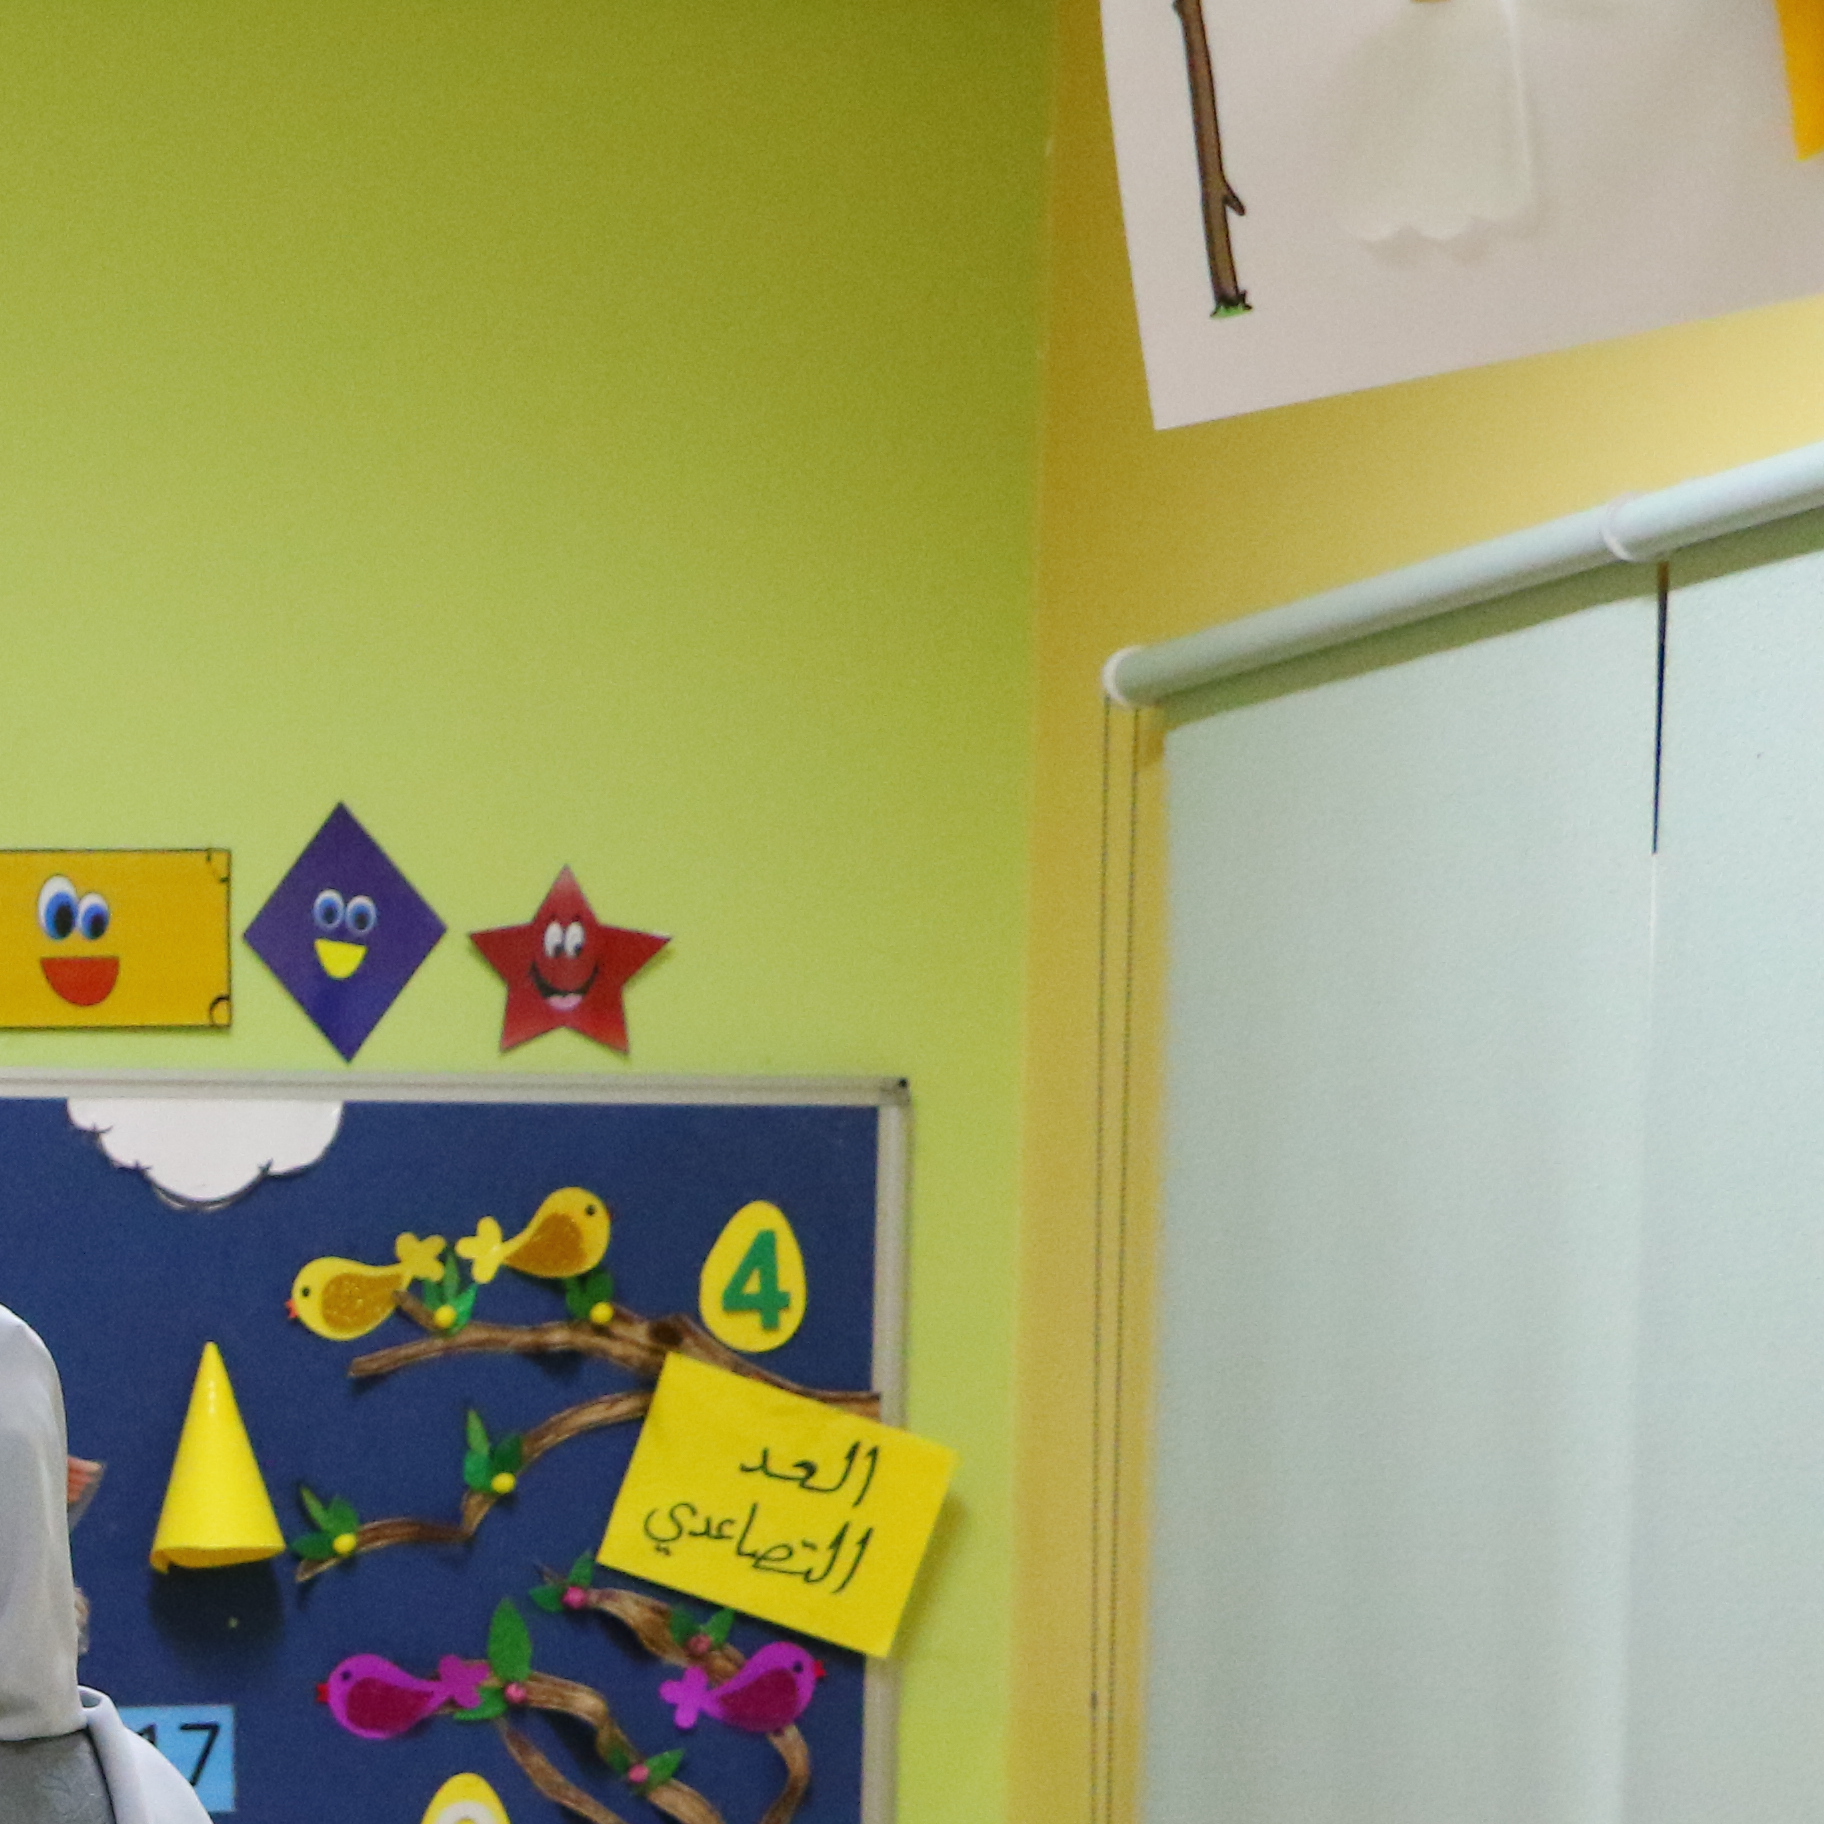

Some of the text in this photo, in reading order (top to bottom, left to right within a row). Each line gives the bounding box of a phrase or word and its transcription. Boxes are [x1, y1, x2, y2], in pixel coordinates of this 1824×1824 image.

[722, 1228, 790, 1332] 4
[739, 1440, 881, 1508] العد
[644, 1502, 874, 1595] التصاعدي
